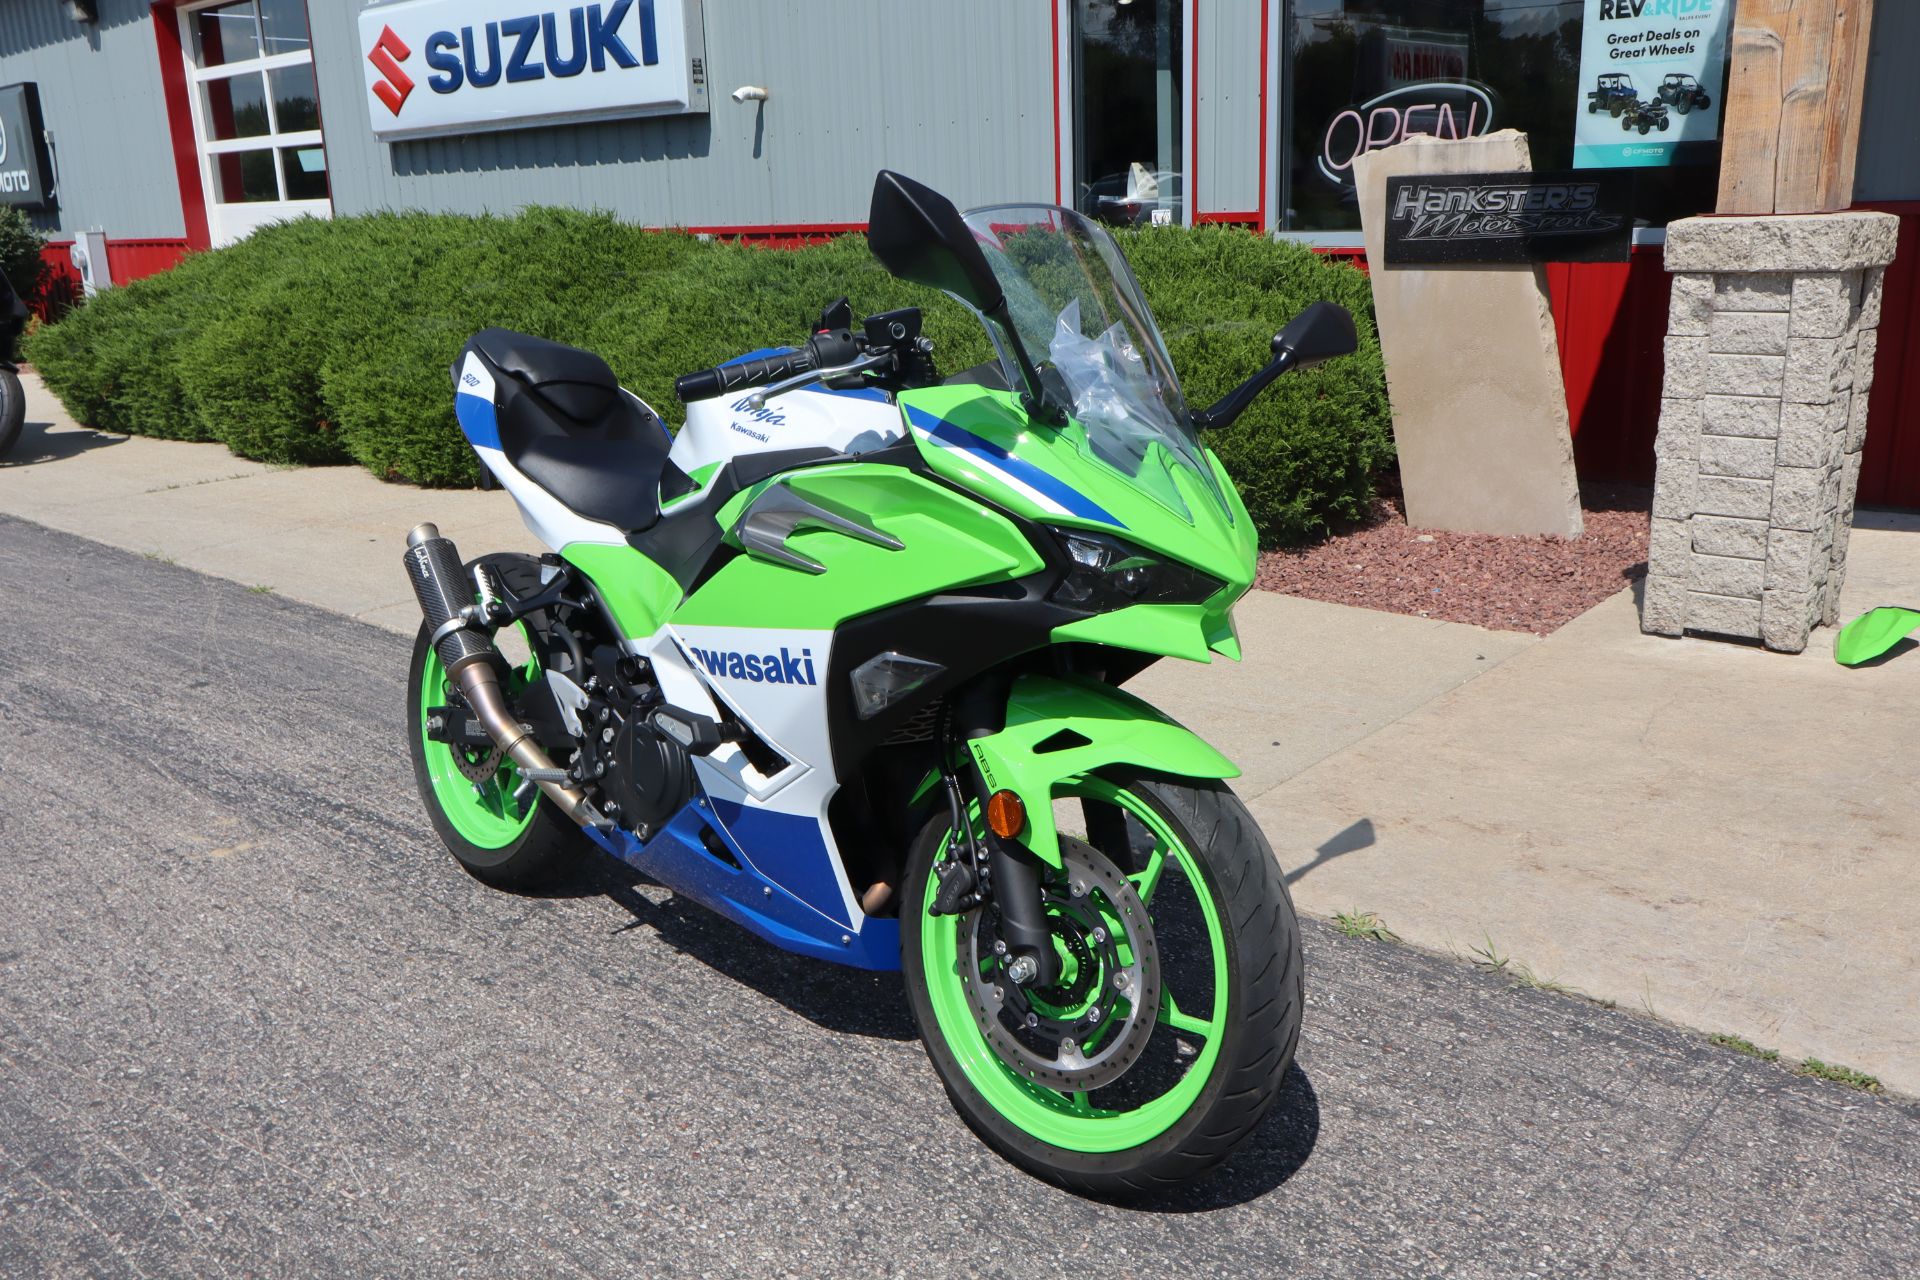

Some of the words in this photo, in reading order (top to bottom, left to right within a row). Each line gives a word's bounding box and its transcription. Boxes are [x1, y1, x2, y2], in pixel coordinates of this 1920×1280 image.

[425, 0, 659, 94] SUZUKI
[1607, 32, 1644, 45] Great
[1646, 28, 1681, 42] Deals
[1684, 29, 1701, 39] on
[1609, 46, 1646, 59] Great
[1649, 42, 1695, 56] Wheels
[1324, 101, 1477, 171] OPEN
[462, 373, 481, 387] 500
[730, 421, 770, 443] Kawasaki
[974, 744, 997, 788] ABS
